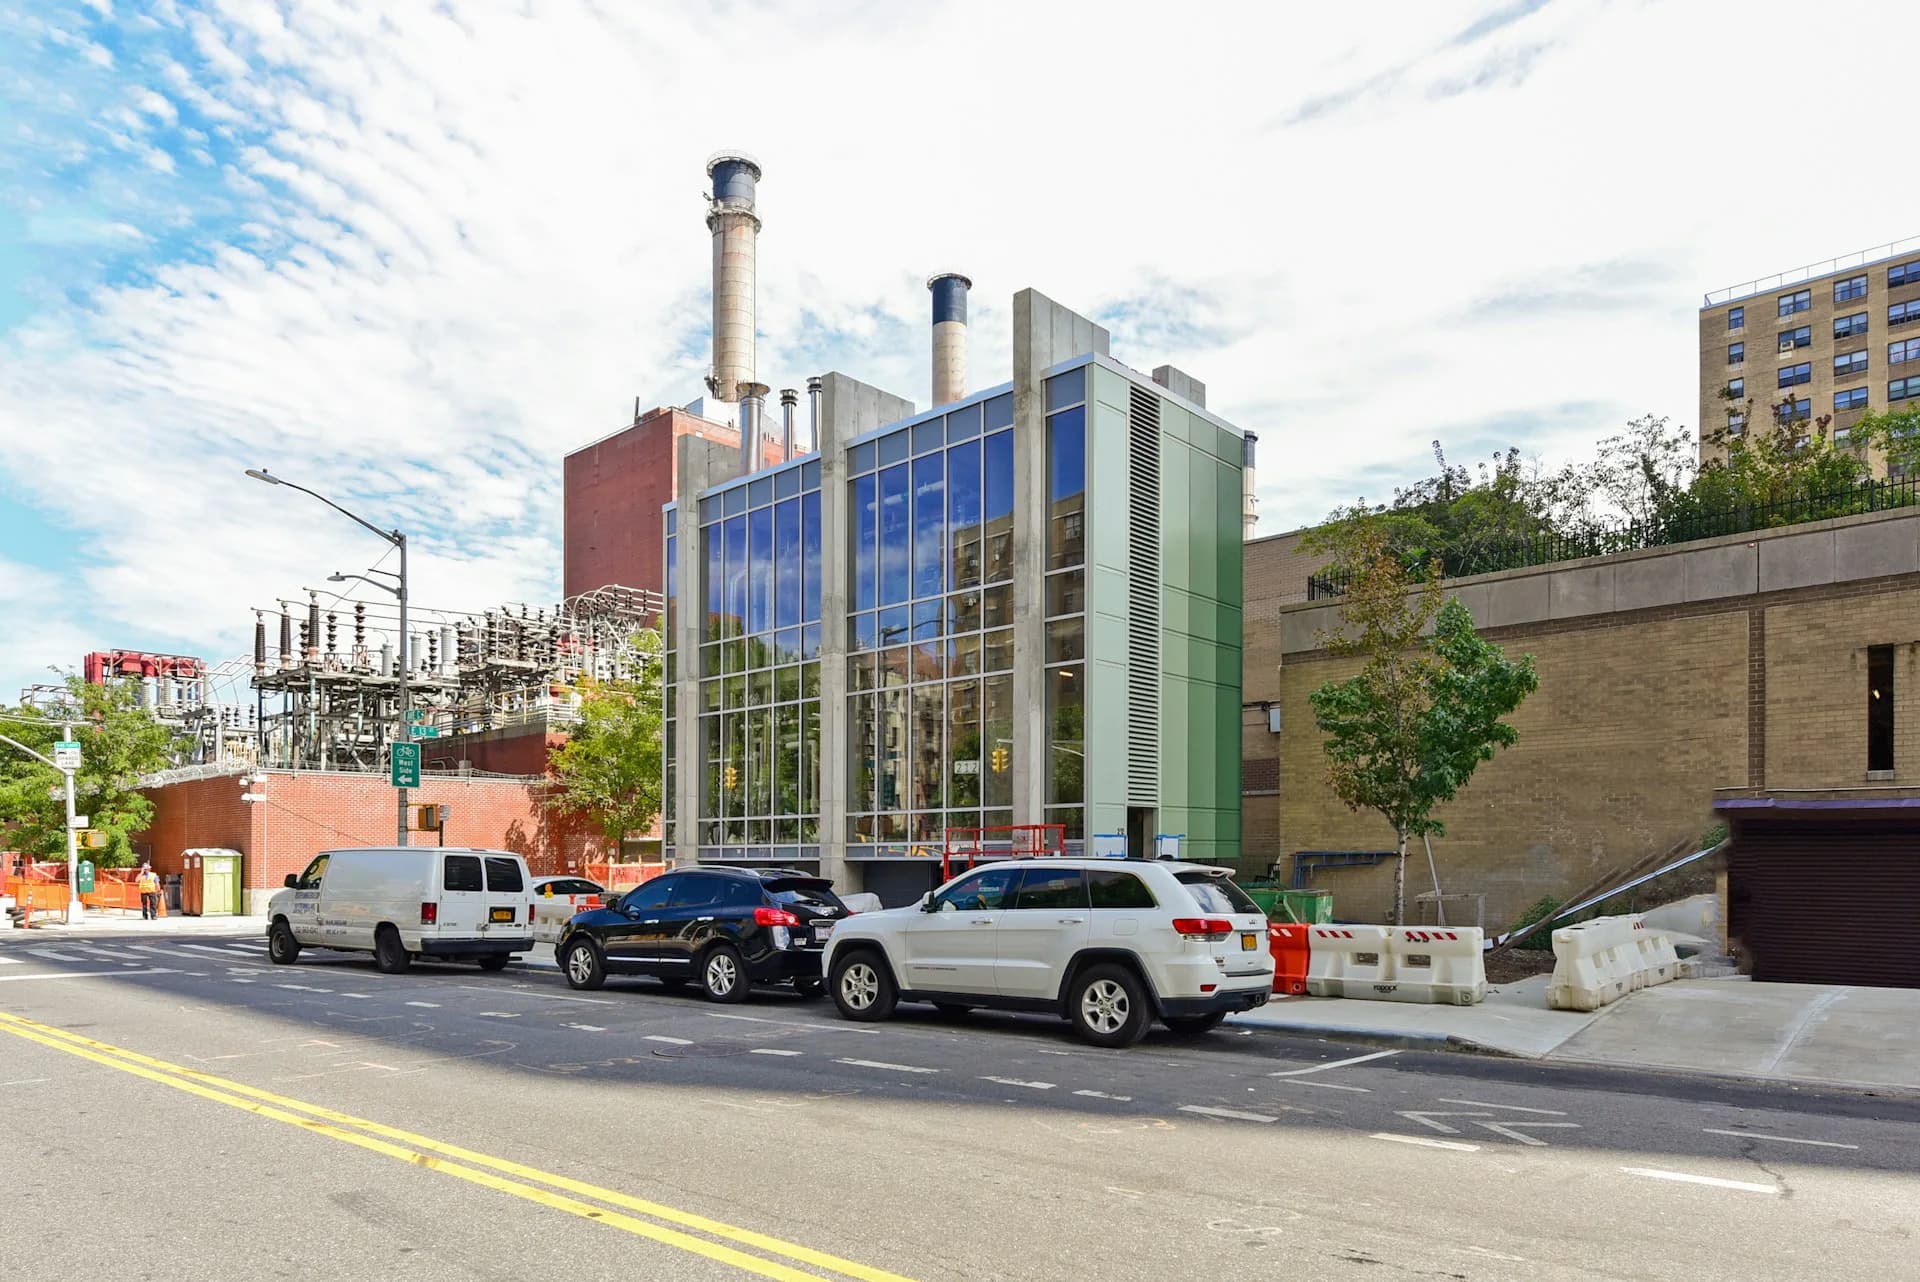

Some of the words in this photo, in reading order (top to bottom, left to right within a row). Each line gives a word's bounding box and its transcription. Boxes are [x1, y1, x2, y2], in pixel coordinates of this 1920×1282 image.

[419, 726, 427, 735] 13
[398, 759, 413, 767] West
[399, 766, 413, 774] Side
